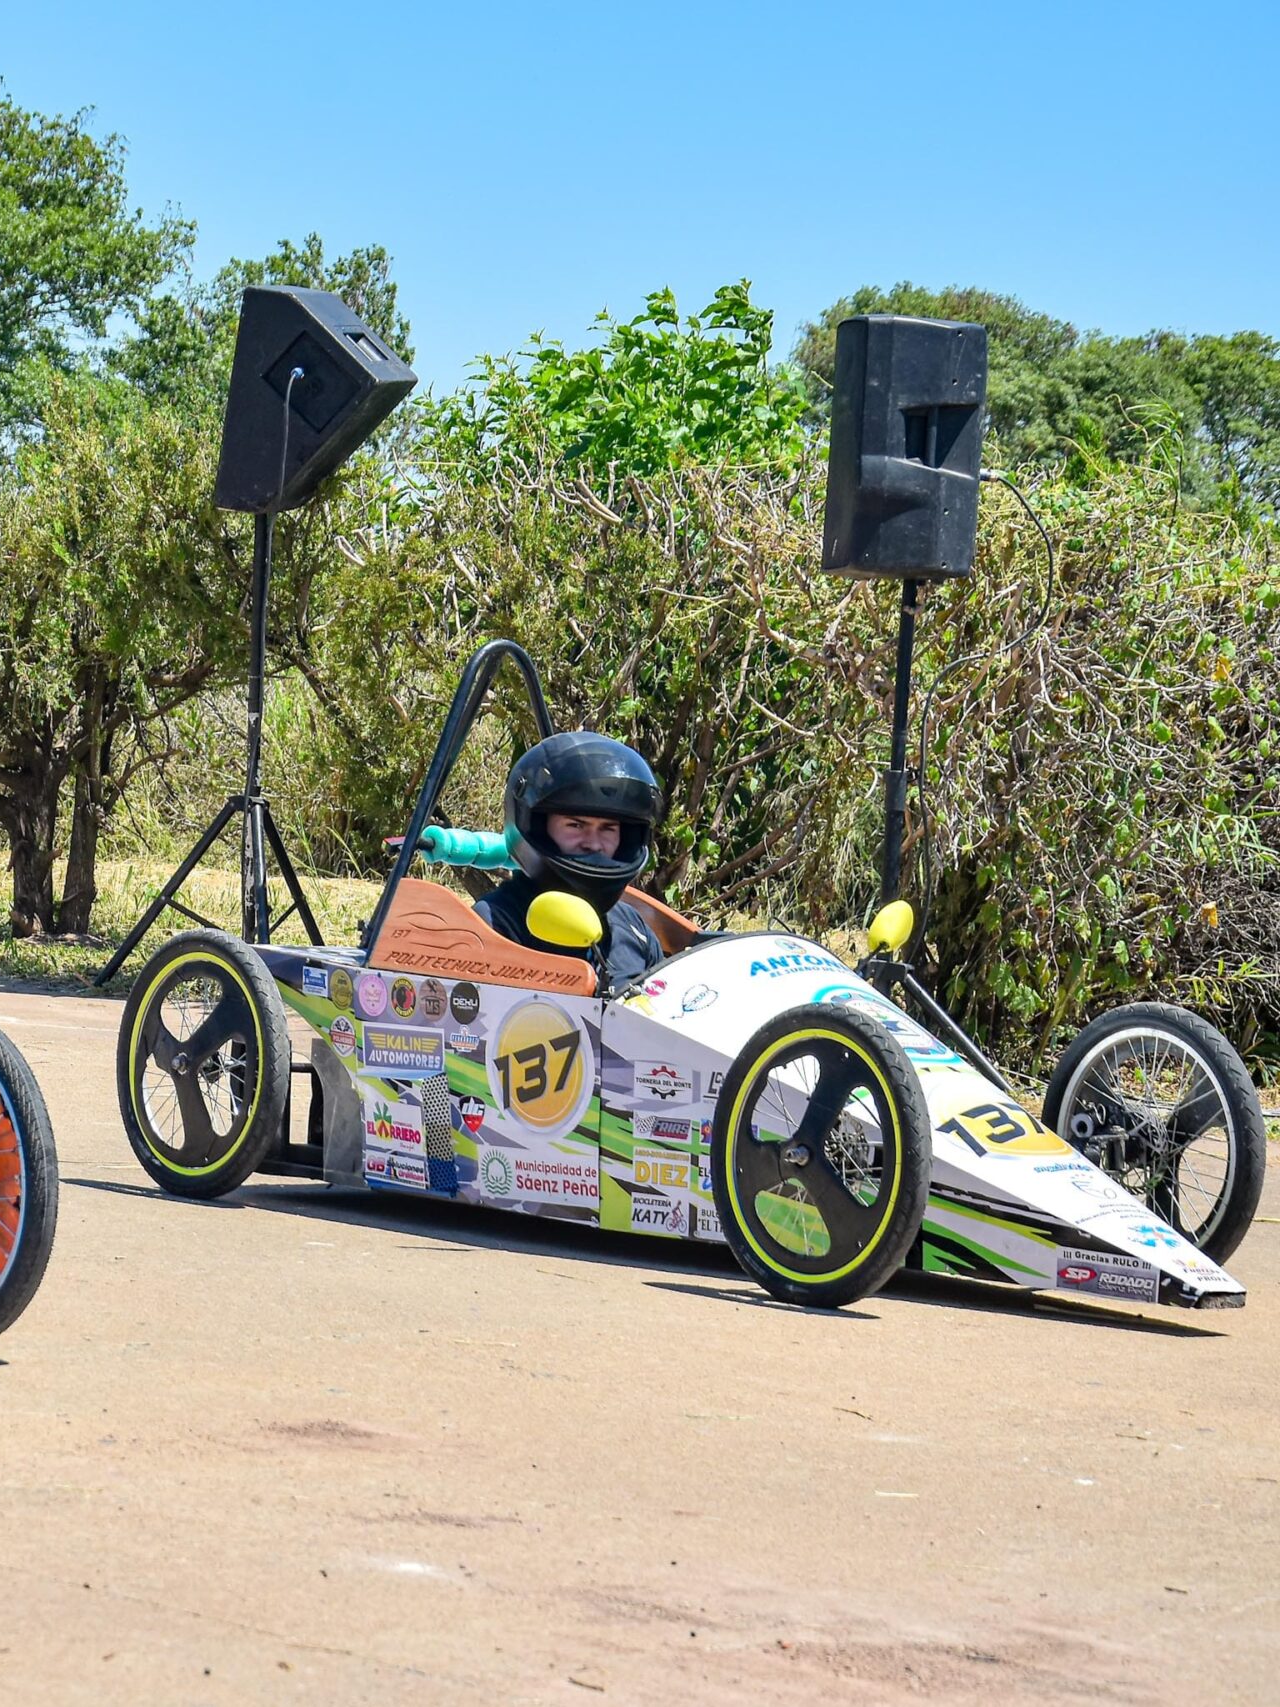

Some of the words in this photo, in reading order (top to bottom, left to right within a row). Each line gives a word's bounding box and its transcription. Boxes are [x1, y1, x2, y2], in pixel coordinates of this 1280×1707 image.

[386, 1034, 422, 1051] KALIN
[368, 1049, 441, 1069] AUTOMOTORES
[493, 1030, 581, 1110] 137
[514, 1160, 582, 1177] Municipalidad
[584, 1164, 597, 1177] de
[634, 1160, 689, 1188] DIEZ
[516, 1173, 559, 1194] Sáenz
[562, 1179, 598, 1197] Peña
[632, 1208, 671, 1225] KATY
[1074, 1251, 1110, 1264] Gracias
[1112, 1257, 1139, 1268] RULO
[1064, 1266, 1091, 1281] SP
[1099, 1272, 1155, 1289] RODADO
